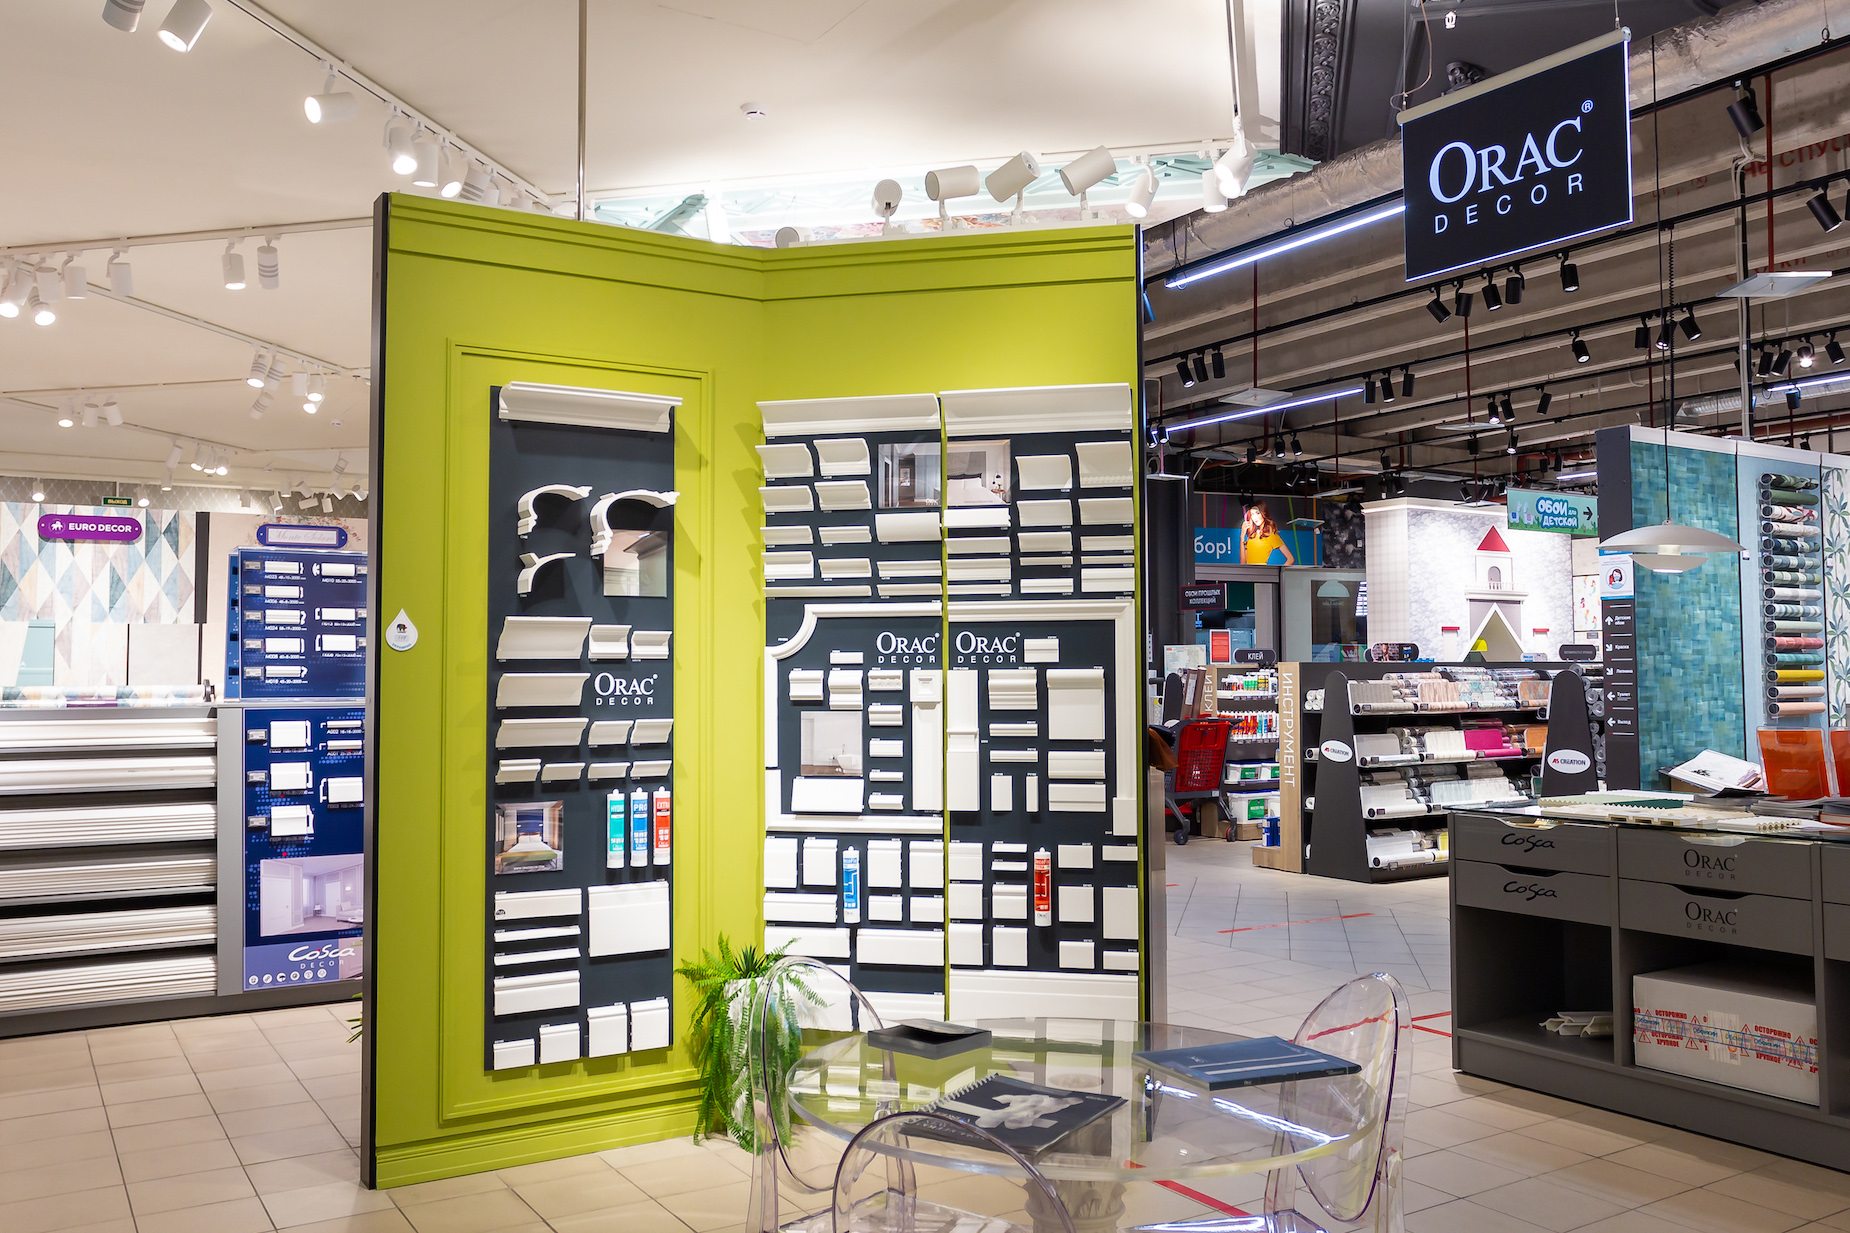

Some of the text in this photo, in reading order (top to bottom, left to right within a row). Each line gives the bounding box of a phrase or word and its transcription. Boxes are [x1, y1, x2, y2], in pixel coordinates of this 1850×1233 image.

[1434, 173, 1583, 234] DECOR
[1538, 499, 1568, 514] ОБОИ
[68, 522, 132, 533] EURO DECOR
[1542, 516, 1578, 527] ДЕТСКОЙ
[876, 631, 936, 654] ORAC
[956, 631, 1017, 654] ORAC
[878, 655, 936, 664] DECOR
[958, 655, 1016, 664] DECOR
[1248, 652, 1264, 660] КЛЕЙ
[594, 672, 654, 696] ORAC
[596, 697, 654, 706] DECOR
[1282, 672, 1295, 788] ИНСТРУМЕНТ
[1684, 849, 1736, 871] ORAC
[1685, 870, 1736, 880] DECOR
[1685, 902, 1737, 926] ORAC
[1687, 922, 1737, 934] DECOR
[300, 960, 344, 970] DECOR
[1655, 1009, 1688, 1020] ОСТОРОЖНО
[1754, 1024, 1792, 1040] ОСТОРОЖНО
